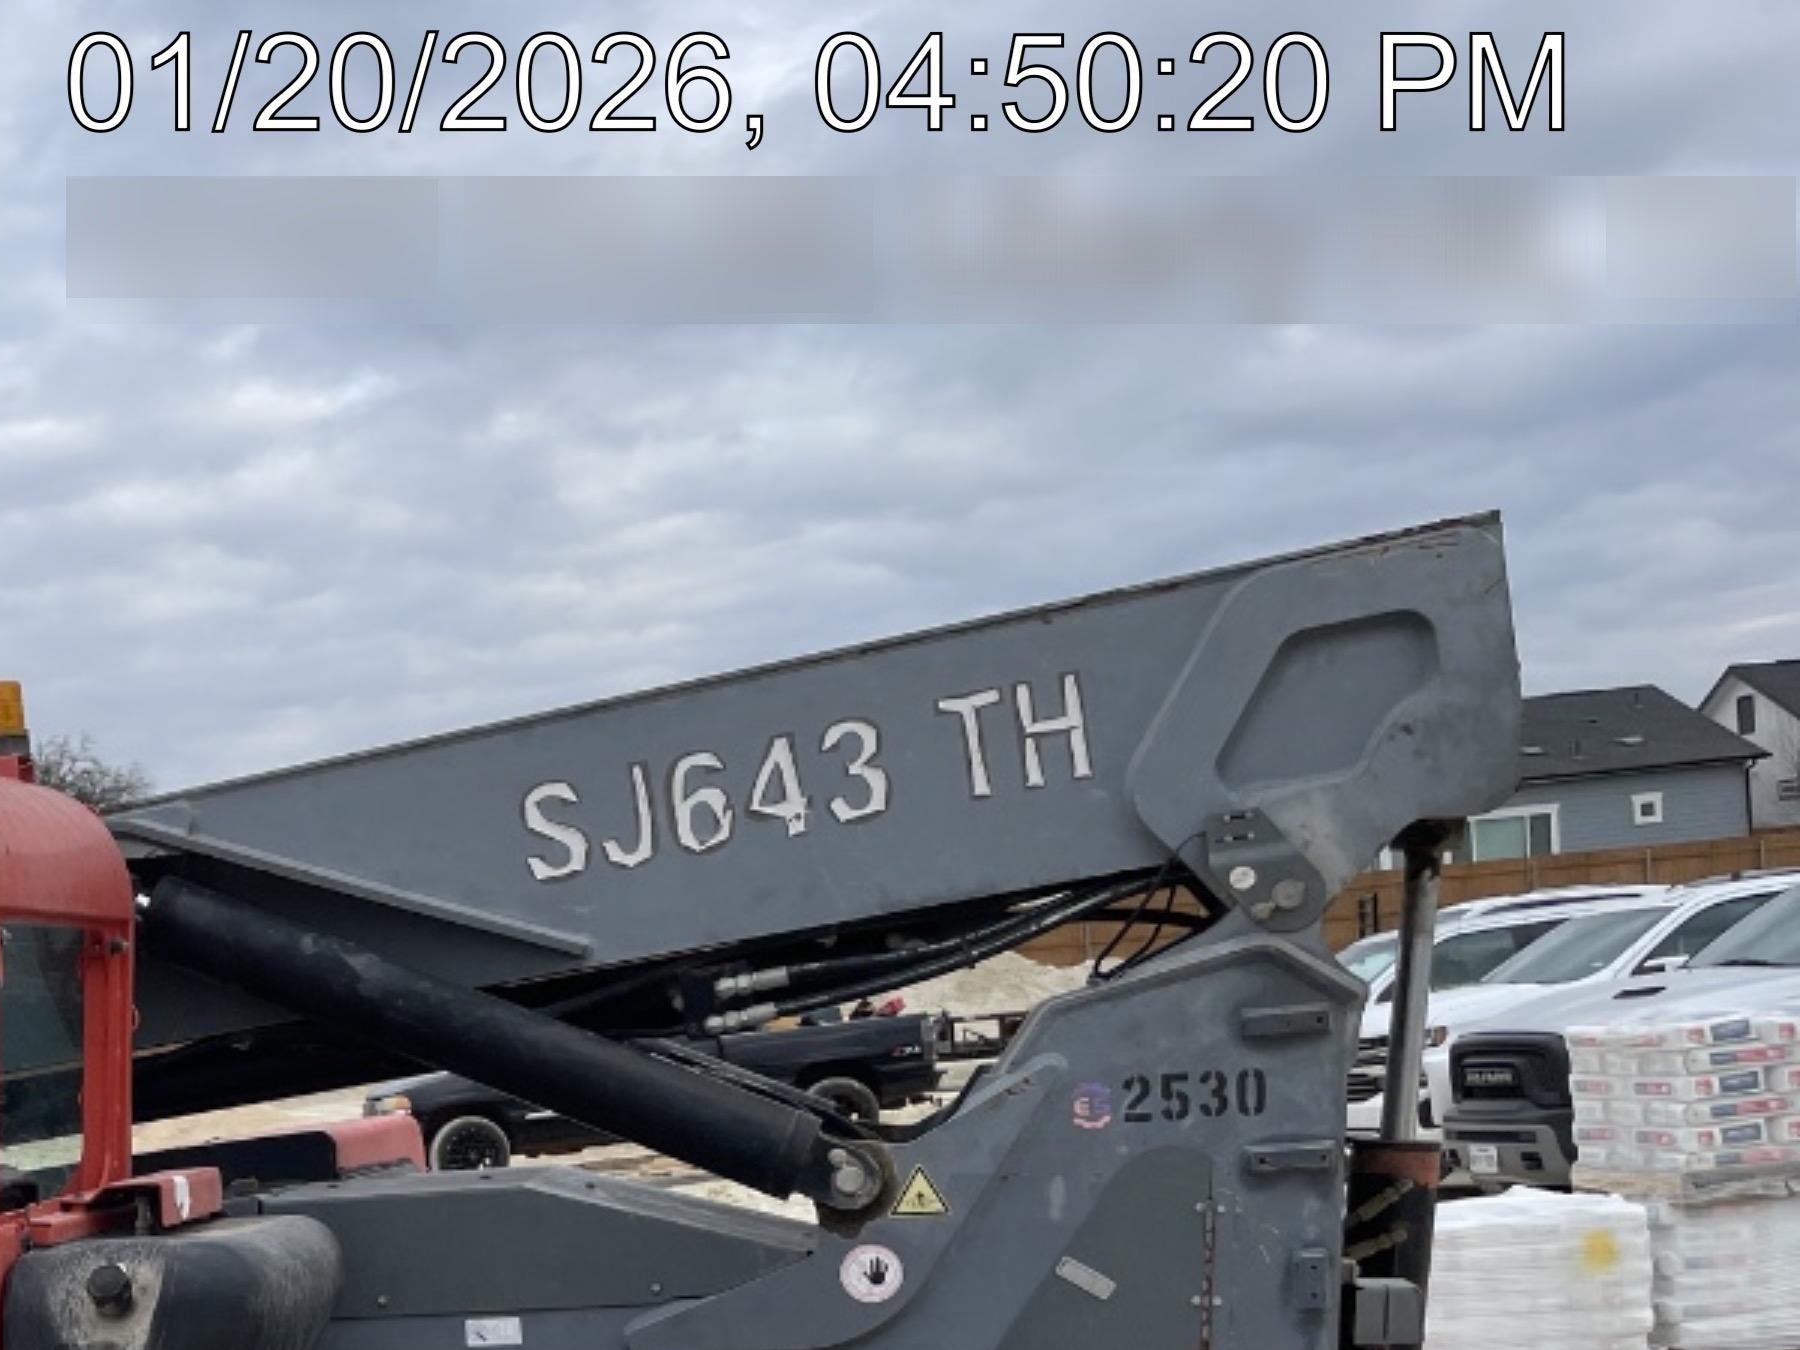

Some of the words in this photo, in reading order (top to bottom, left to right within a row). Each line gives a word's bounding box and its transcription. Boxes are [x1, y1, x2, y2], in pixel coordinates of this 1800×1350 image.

[522, 721, 889, 881] SJ643
[938, 674, 1093, 798] TH
[1122, 1067, 1268, 1123] 2530
